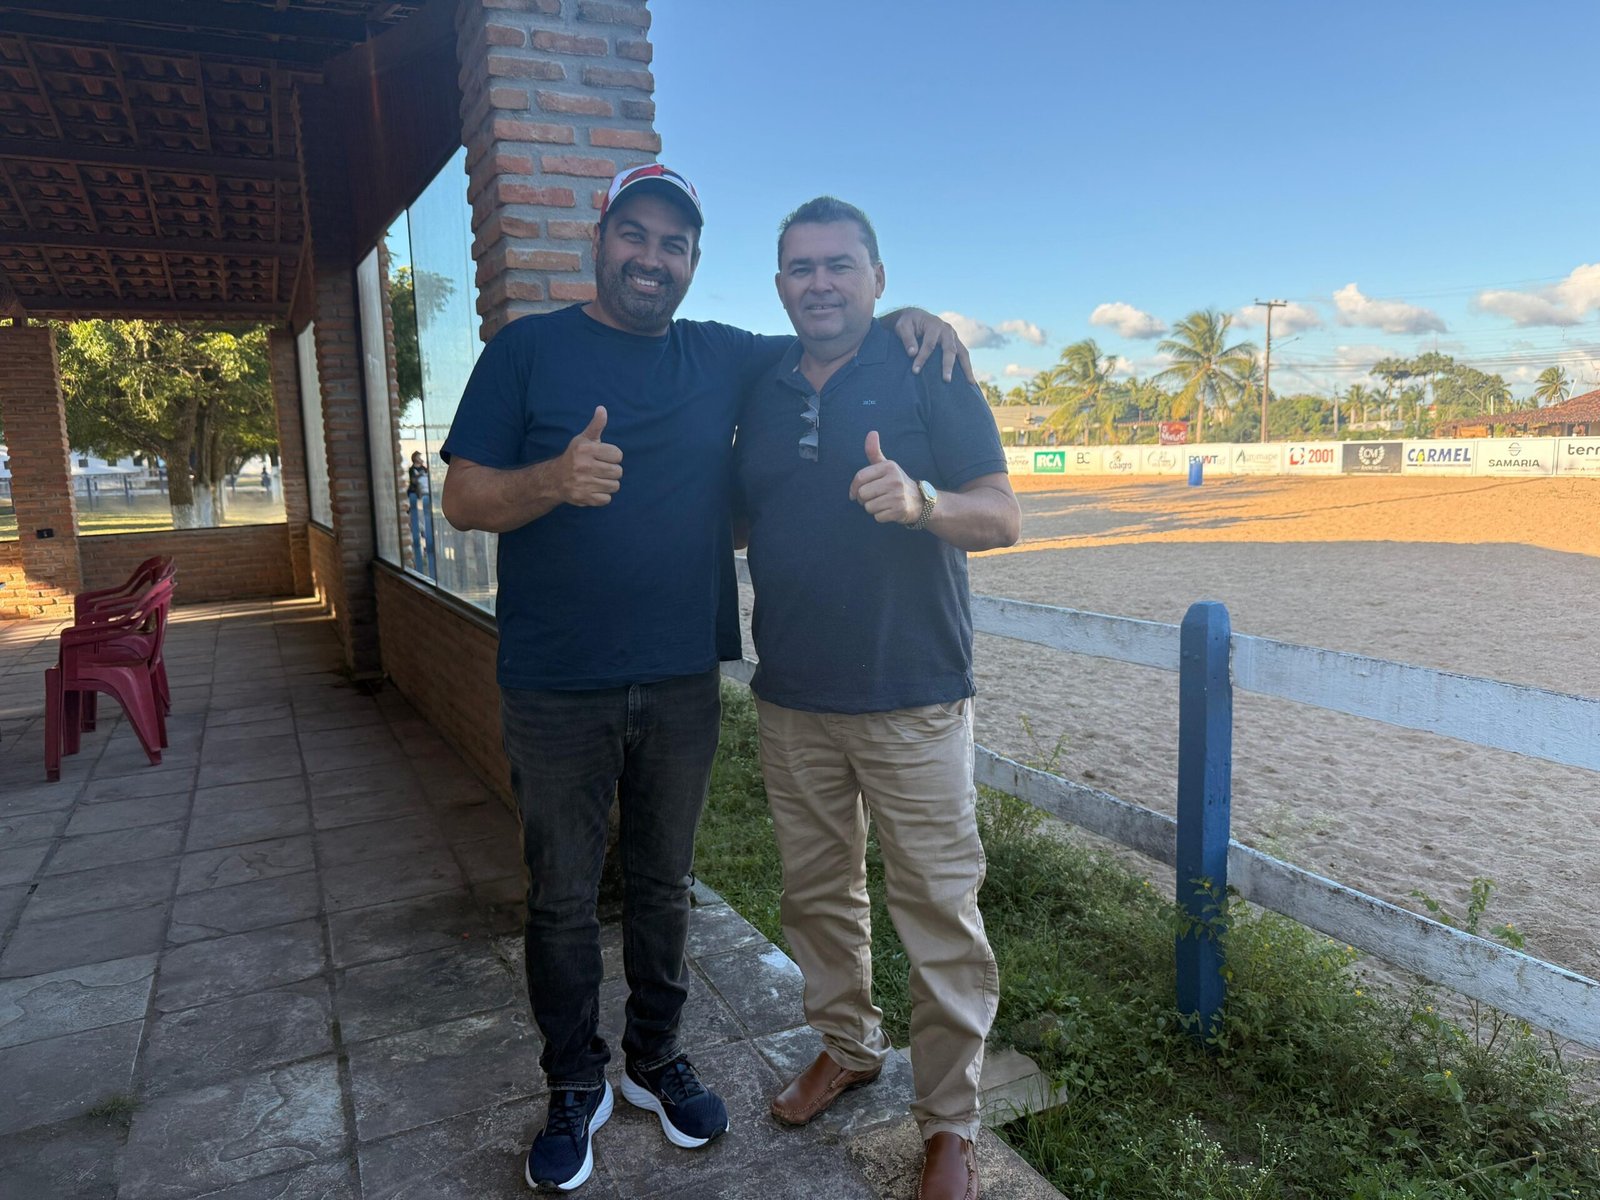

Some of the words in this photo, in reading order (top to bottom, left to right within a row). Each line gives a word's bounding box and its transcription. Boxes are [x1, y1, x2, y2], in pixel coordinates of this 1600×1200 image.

[1308, 449, 1334, 463] 2001
[1407, 447, 1472, 462] CARMEL
[1488, 459, 1540, 468] SAMARIA
